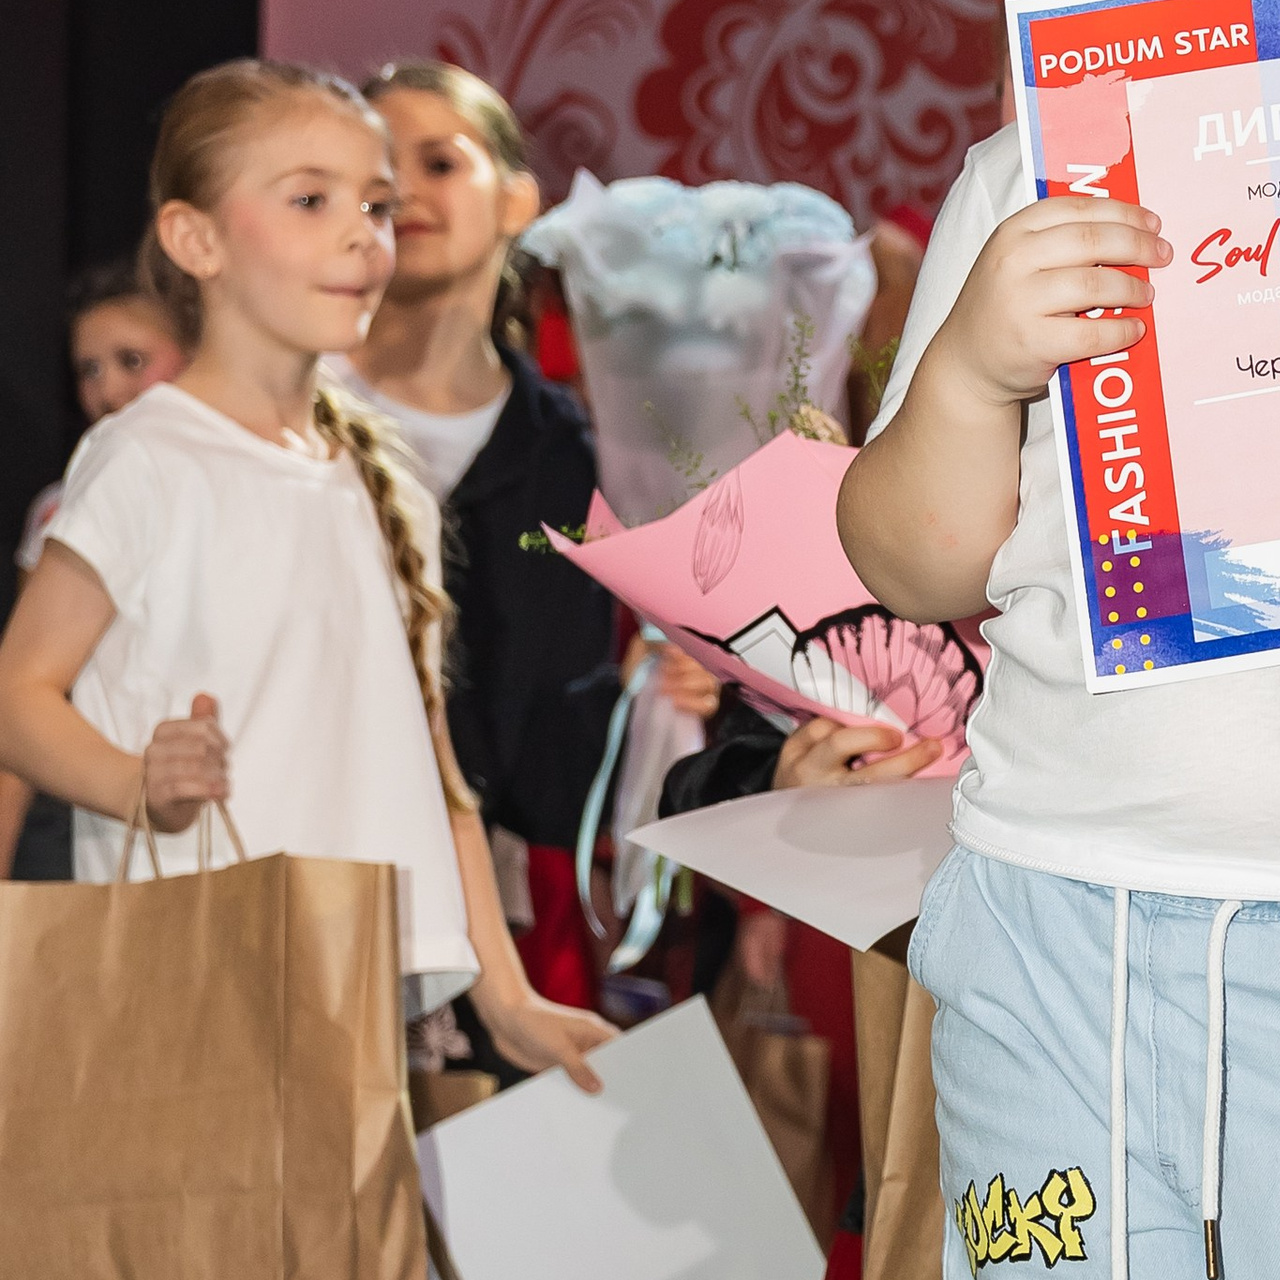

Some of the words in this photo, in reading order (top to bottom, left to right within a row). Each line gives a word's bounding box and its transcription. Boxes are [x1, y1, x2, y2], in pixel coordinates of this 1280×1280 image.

[1039, 35, 1164, 78] PODIUM
[1174, 23, 1250, 56] STAR
[1089, 351, 1153, 556] FASHIO
